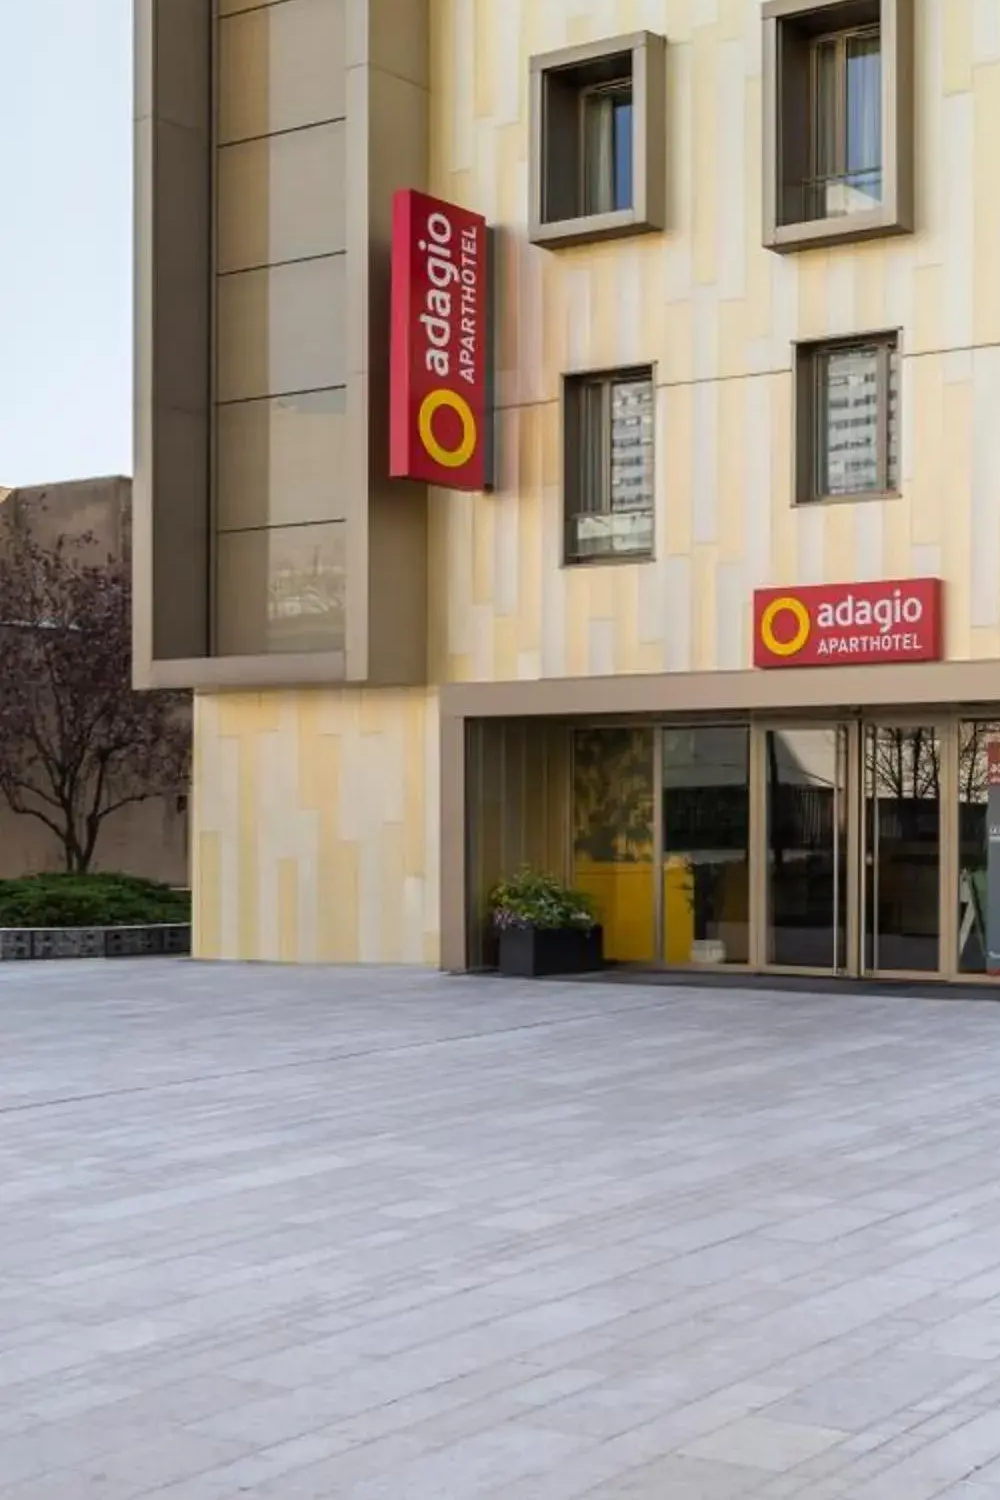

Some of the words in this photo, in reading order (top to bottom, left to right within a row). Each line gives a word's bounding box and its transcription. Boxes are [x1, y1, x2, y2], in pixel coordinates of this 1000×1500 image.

[419, 212, 459, 377] adagio
[459, 226, 478, 384] APARTHOTEL
[816, 589, 923, 633] adagio
[817, 633, 923, 655] APARTHOTEL
